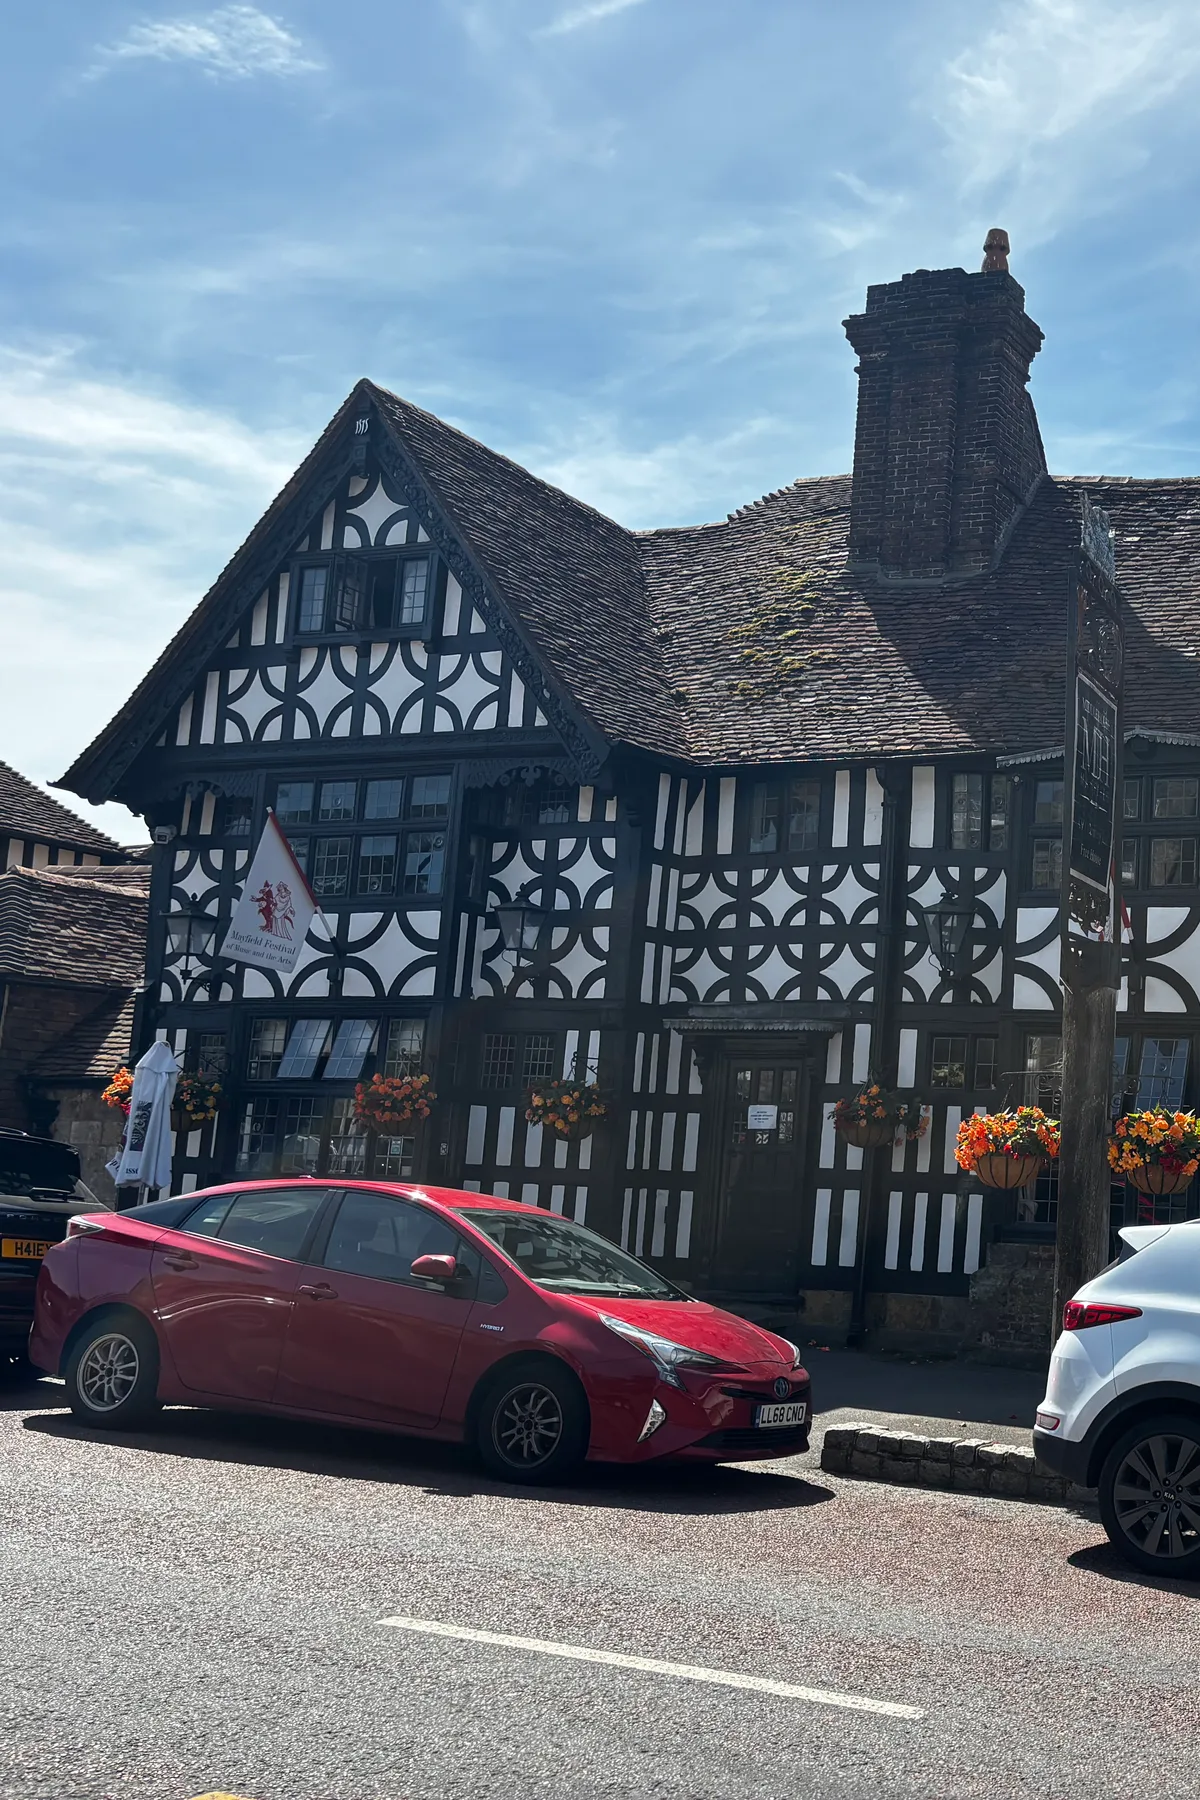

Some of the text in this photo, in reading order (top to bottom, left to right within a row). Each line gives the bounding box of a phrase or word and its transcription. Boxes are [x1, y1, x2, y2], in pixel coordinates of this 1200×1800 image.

[355, 418, 370, 435] 1575
[230, 930, 296, 955] Mayfield Festival
[234, 944, 251, 953] Music
[252, 950, 265, 958] and
[277, 956, 292, 965] Arts
[760, 1405, 804, 1424] LL68 CNO
[1163, 1491, 1175, 1500] KIA
